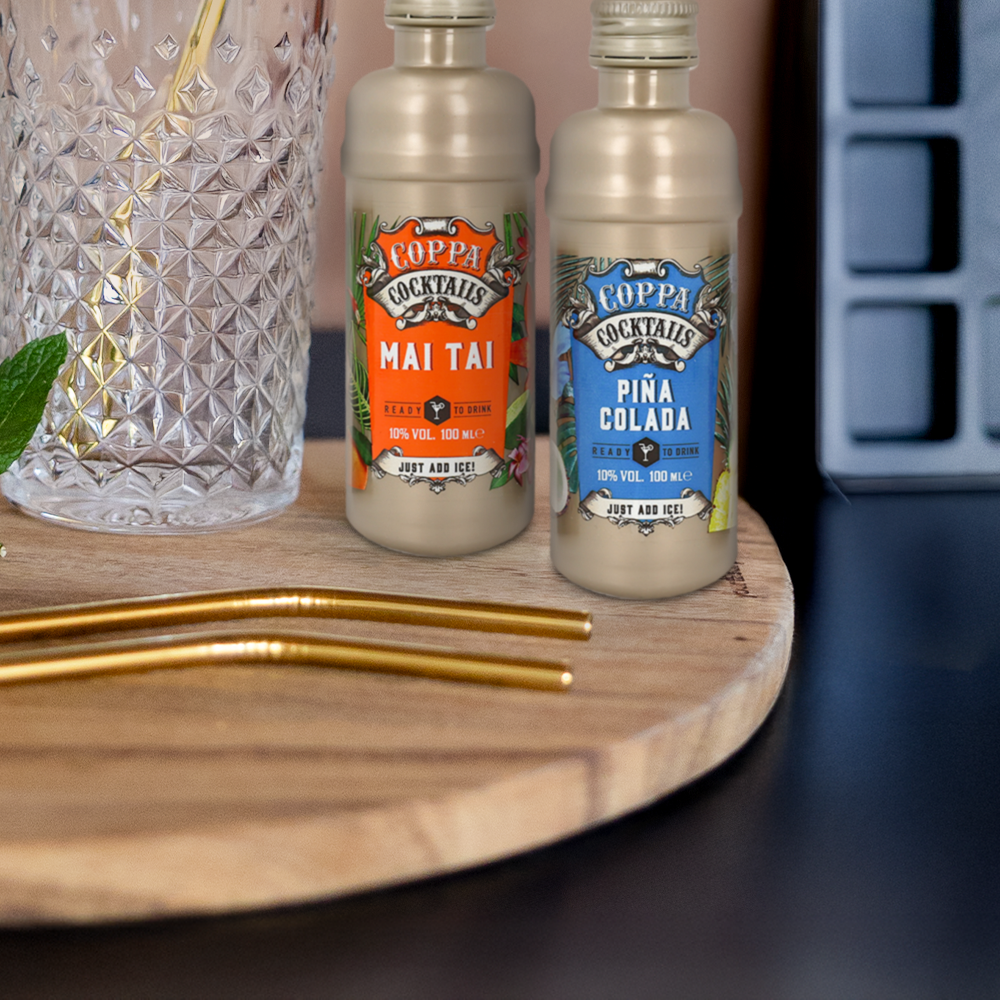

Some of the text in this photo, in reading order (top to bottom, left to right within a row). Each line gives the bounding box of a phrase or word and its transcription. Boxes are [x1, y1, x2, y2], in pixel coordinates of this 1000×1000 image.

[391, 240, 482, 271] COPPA
[388, 274, 487, 306] COCKTAILS
[599, 282, 692, 313] COPPA
[596, 317, 695, 348] COCKTAILS
[380, 340, 494, 371] MAI TAI
[617, 372, 675, 403] PIÑA
[384, 404, 492, 415] READY TO DRINK
[600, 406, 692, 432] COLADA
[389, 427, 410, 440] 10%
[411, 428, 436, 441] VOL.
[441, 428, 459, 440] 100
[592, 446, 699, 457] READY TO DRINK
[398, 461, 475, 473] JUST ADD ICE!
[597, 469, 618, 482] 10%
[620, 470, 645, 482] VOL.
[649, 469, 667, 482] 100
[607, 503, 683, 515] JUST ADD ICE!
